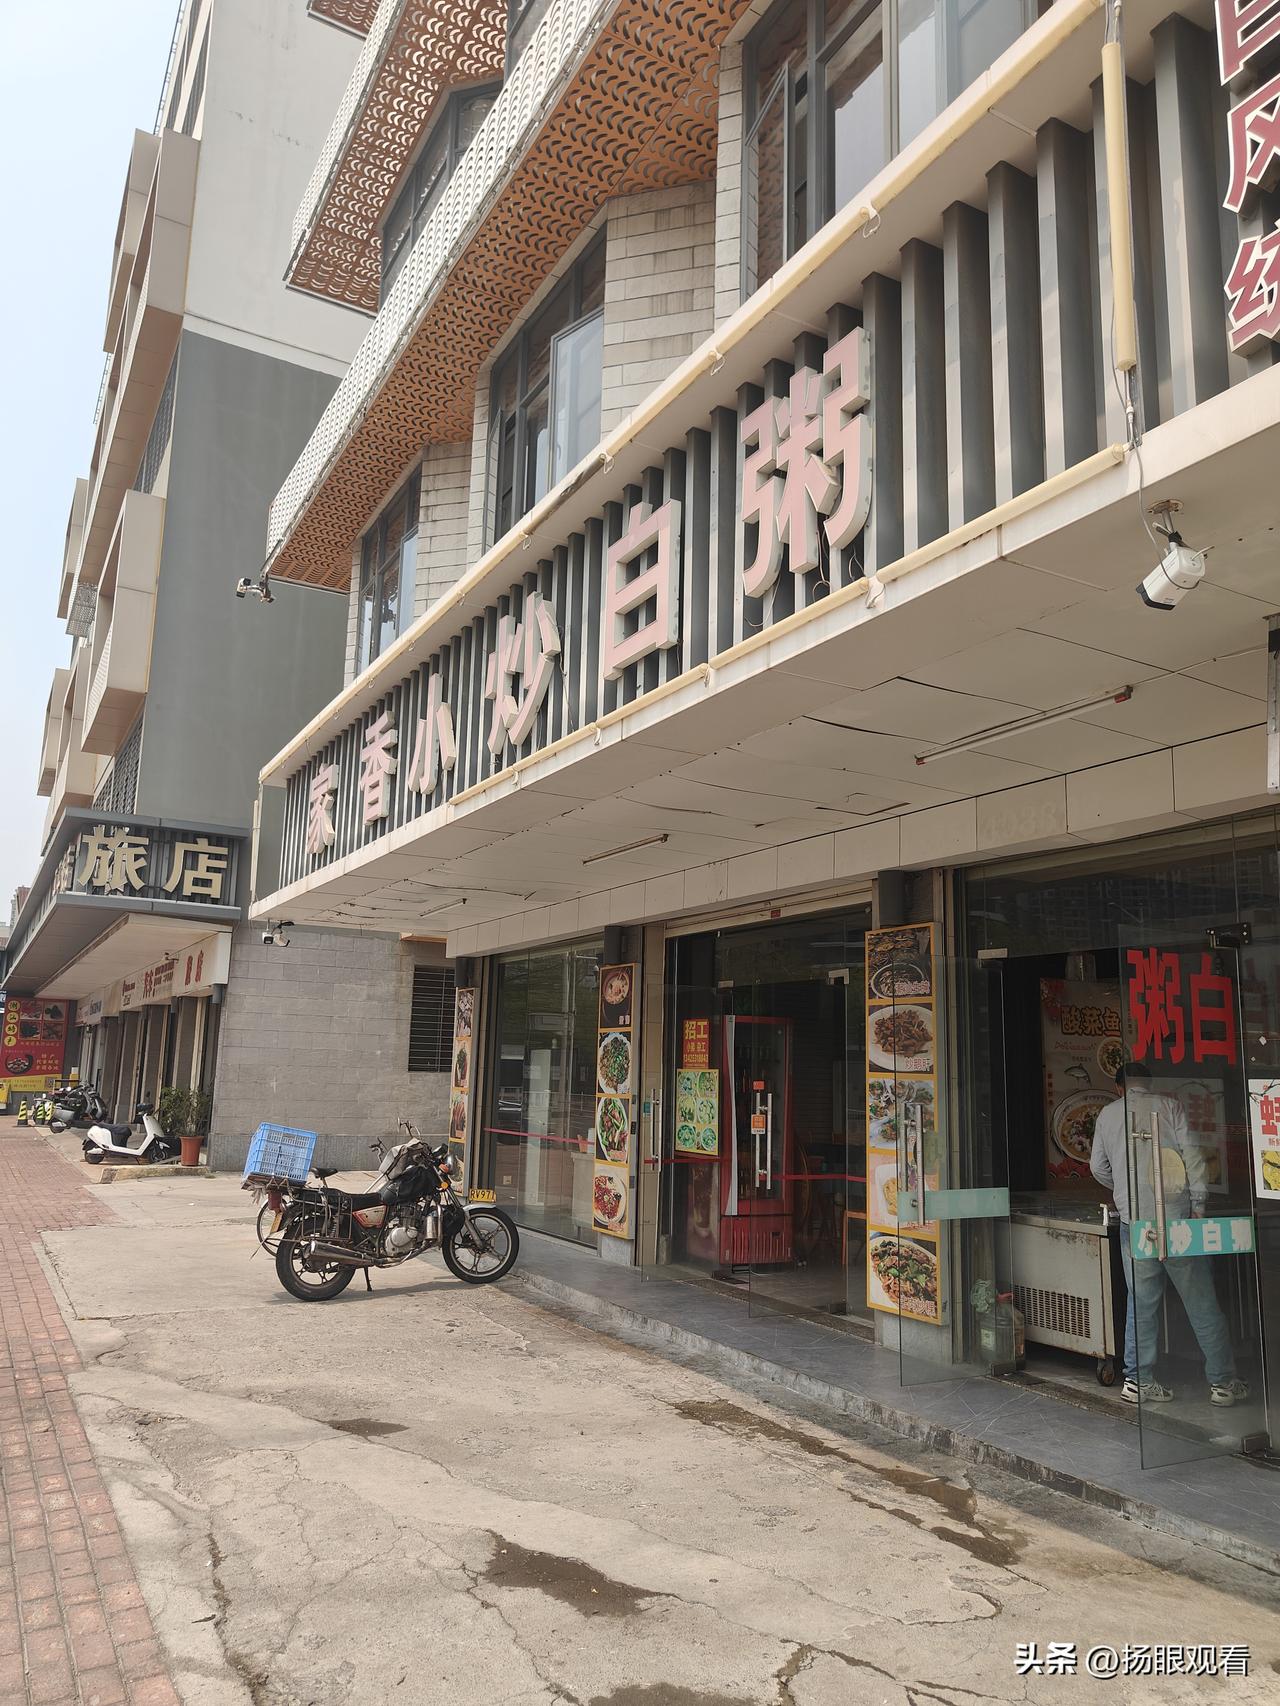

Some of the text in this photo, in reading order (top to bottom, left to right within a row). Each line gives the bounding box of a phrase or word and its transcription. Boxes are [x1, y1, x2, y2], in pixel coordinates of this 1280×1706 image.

[77, 825, 229, 899] 旅店
[685, 1020, 708, 1040] 招工
[1060, 1004, 1121, 1037] 酸菜鱼
